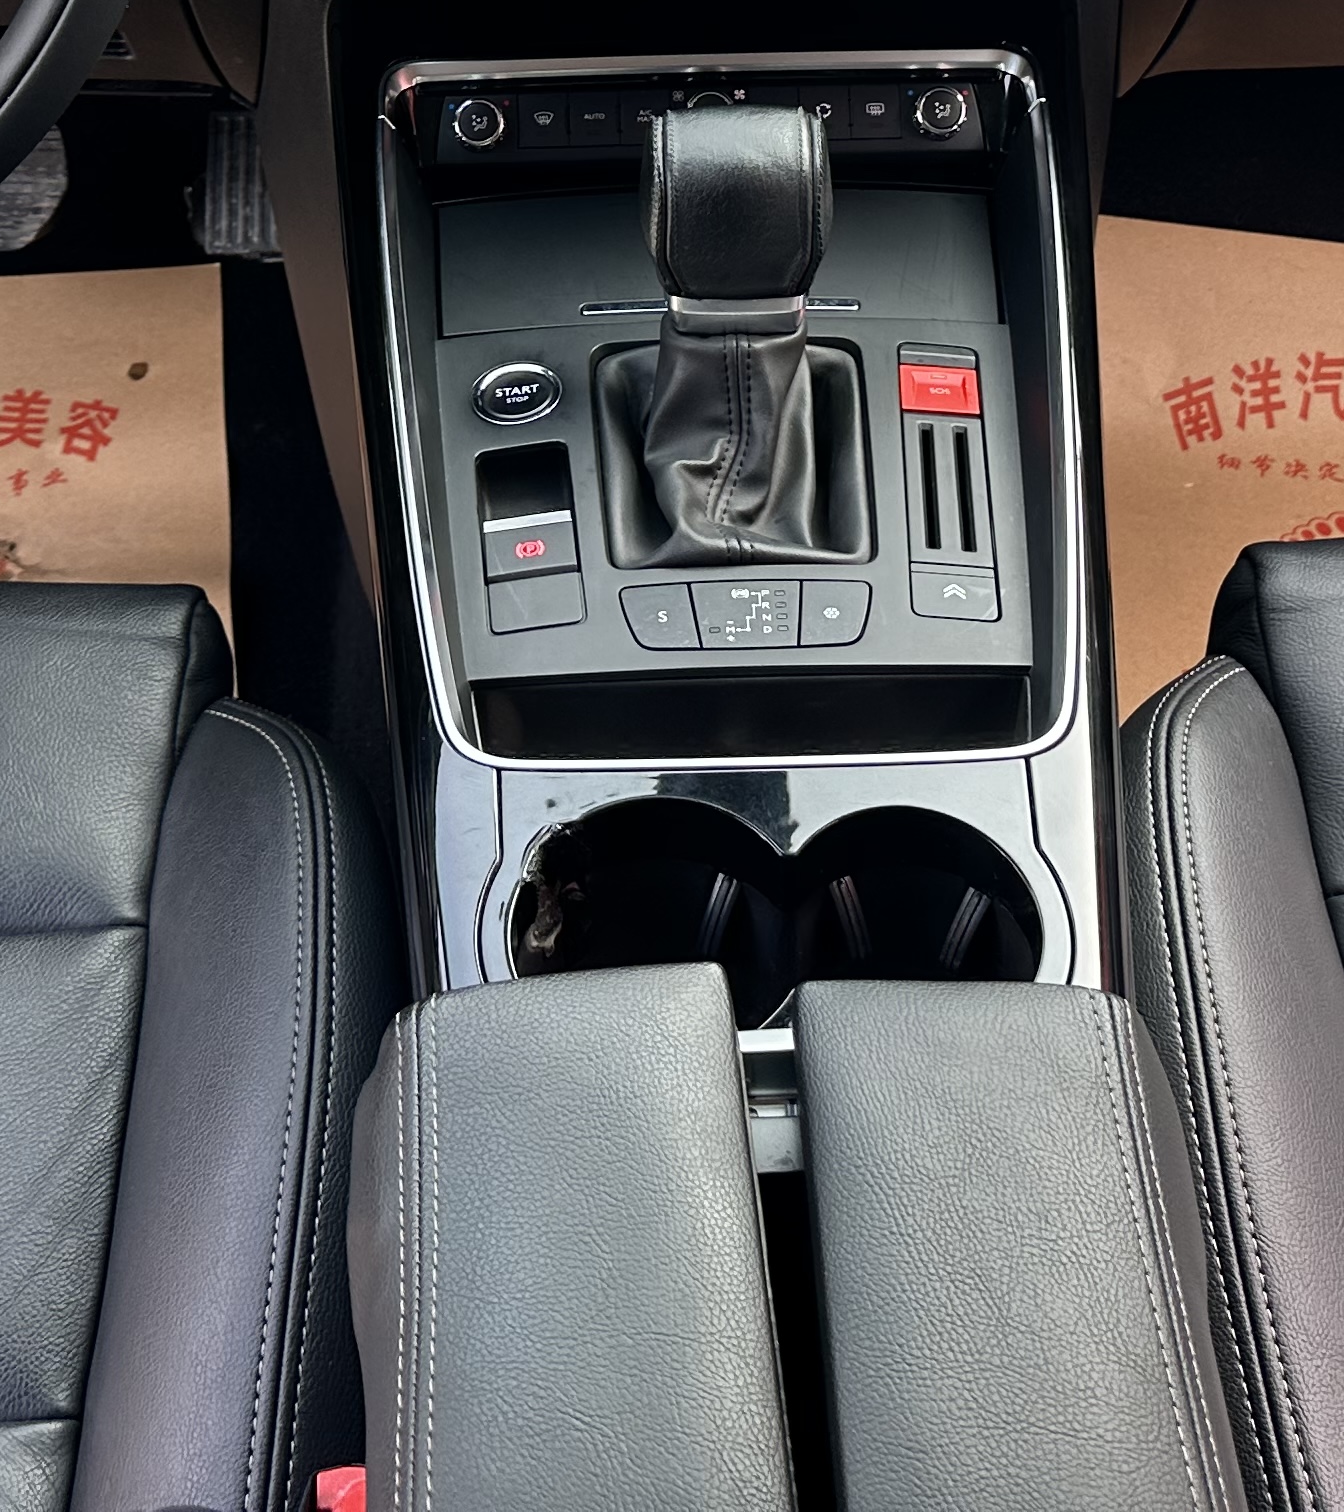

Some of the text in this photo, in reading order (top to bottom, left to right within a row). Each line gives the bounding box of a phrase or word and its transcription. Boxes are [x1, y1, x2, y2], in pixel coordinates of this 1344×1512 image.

[583, 112, 606, 120] AUTO
[494, 383, 540, 398] START
[505, 395, 530, 404] STOP
[761, 601, 771, 610] R
[657, 610, 669, 624] S
[762, 613, 772, 622] N
[763, 625, 773, 634] D
